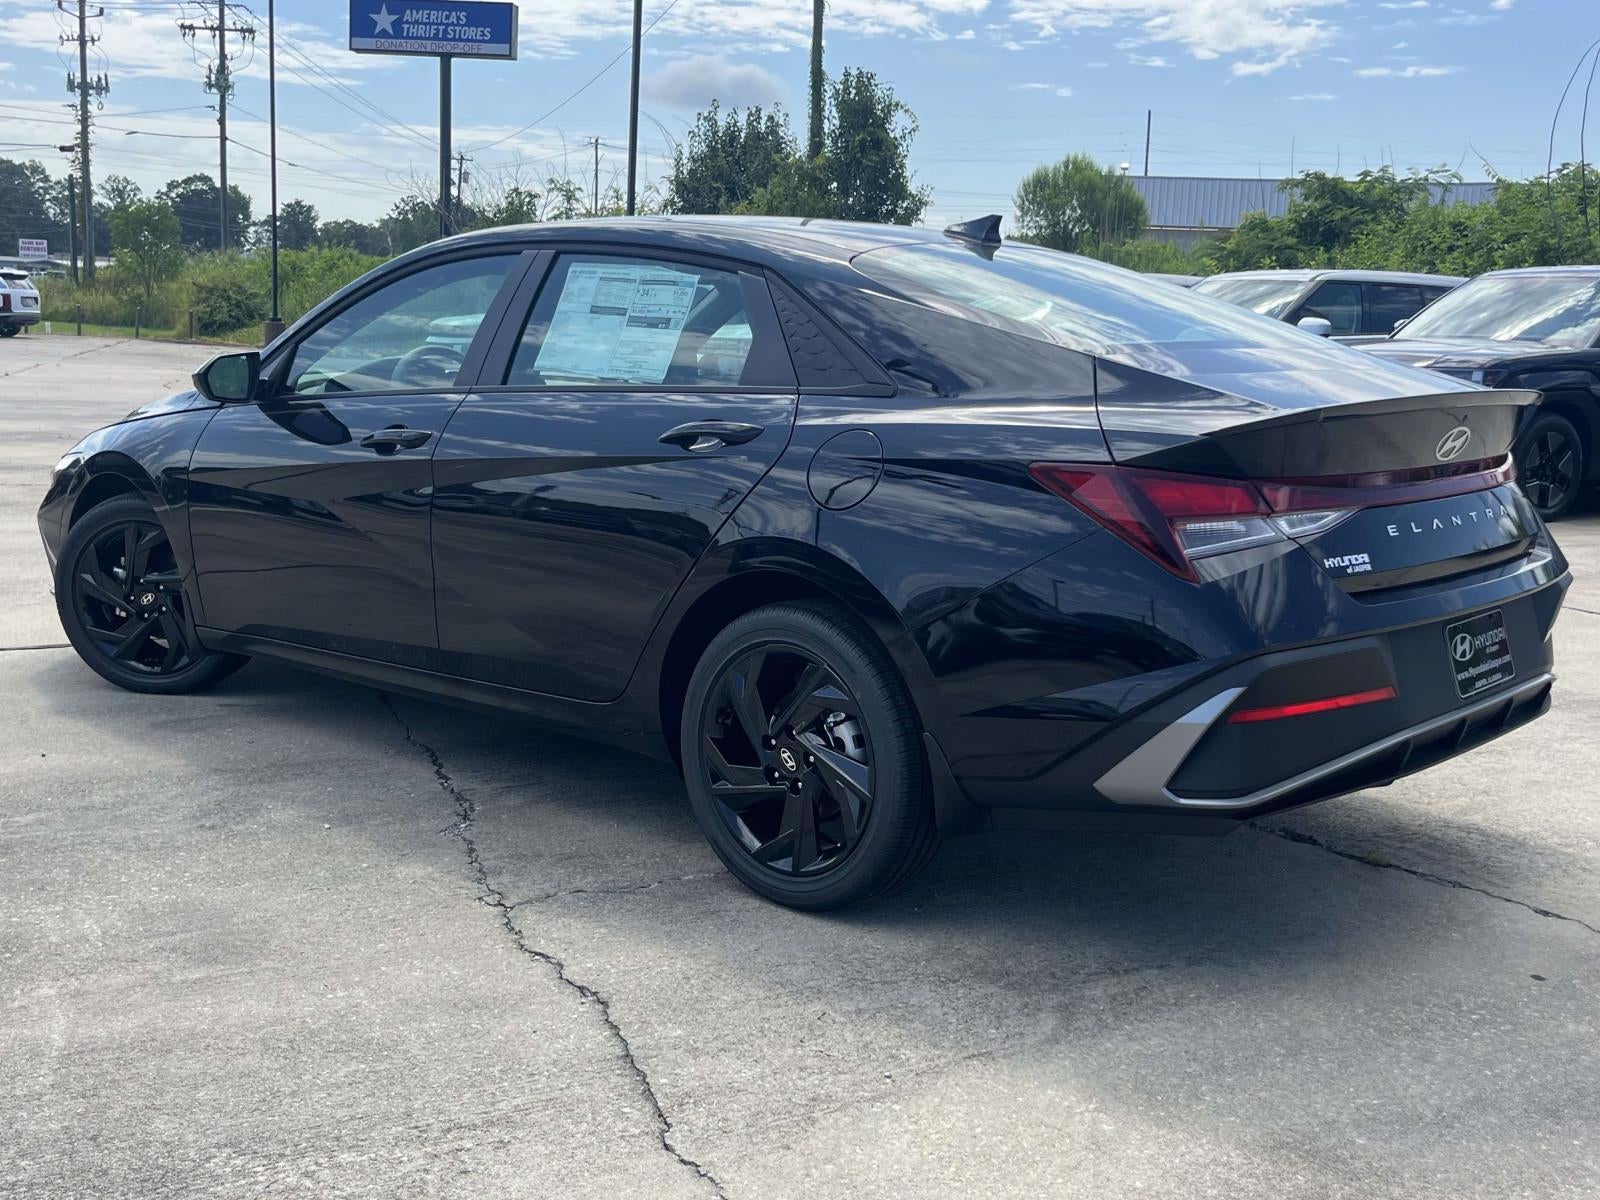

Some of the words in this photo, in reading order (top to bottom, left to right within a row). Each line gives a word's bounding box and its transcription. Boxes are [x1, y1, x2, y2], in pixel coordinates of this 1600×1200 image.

[402, 9, 467, 25] AMERICA'S
[402, 23, 444, 38] THRIFT
[447, 27, 492, 41] STORES
[375, 39, 428, 51] DONATION
[430, 42, 483, 53] DROP-OFF
[1386, 504, 1508, 536] ELANTRA
[1323, 552, 1371, 569] HYUNDAI
[1474, 627, 1506, 648] HYUNDAI
